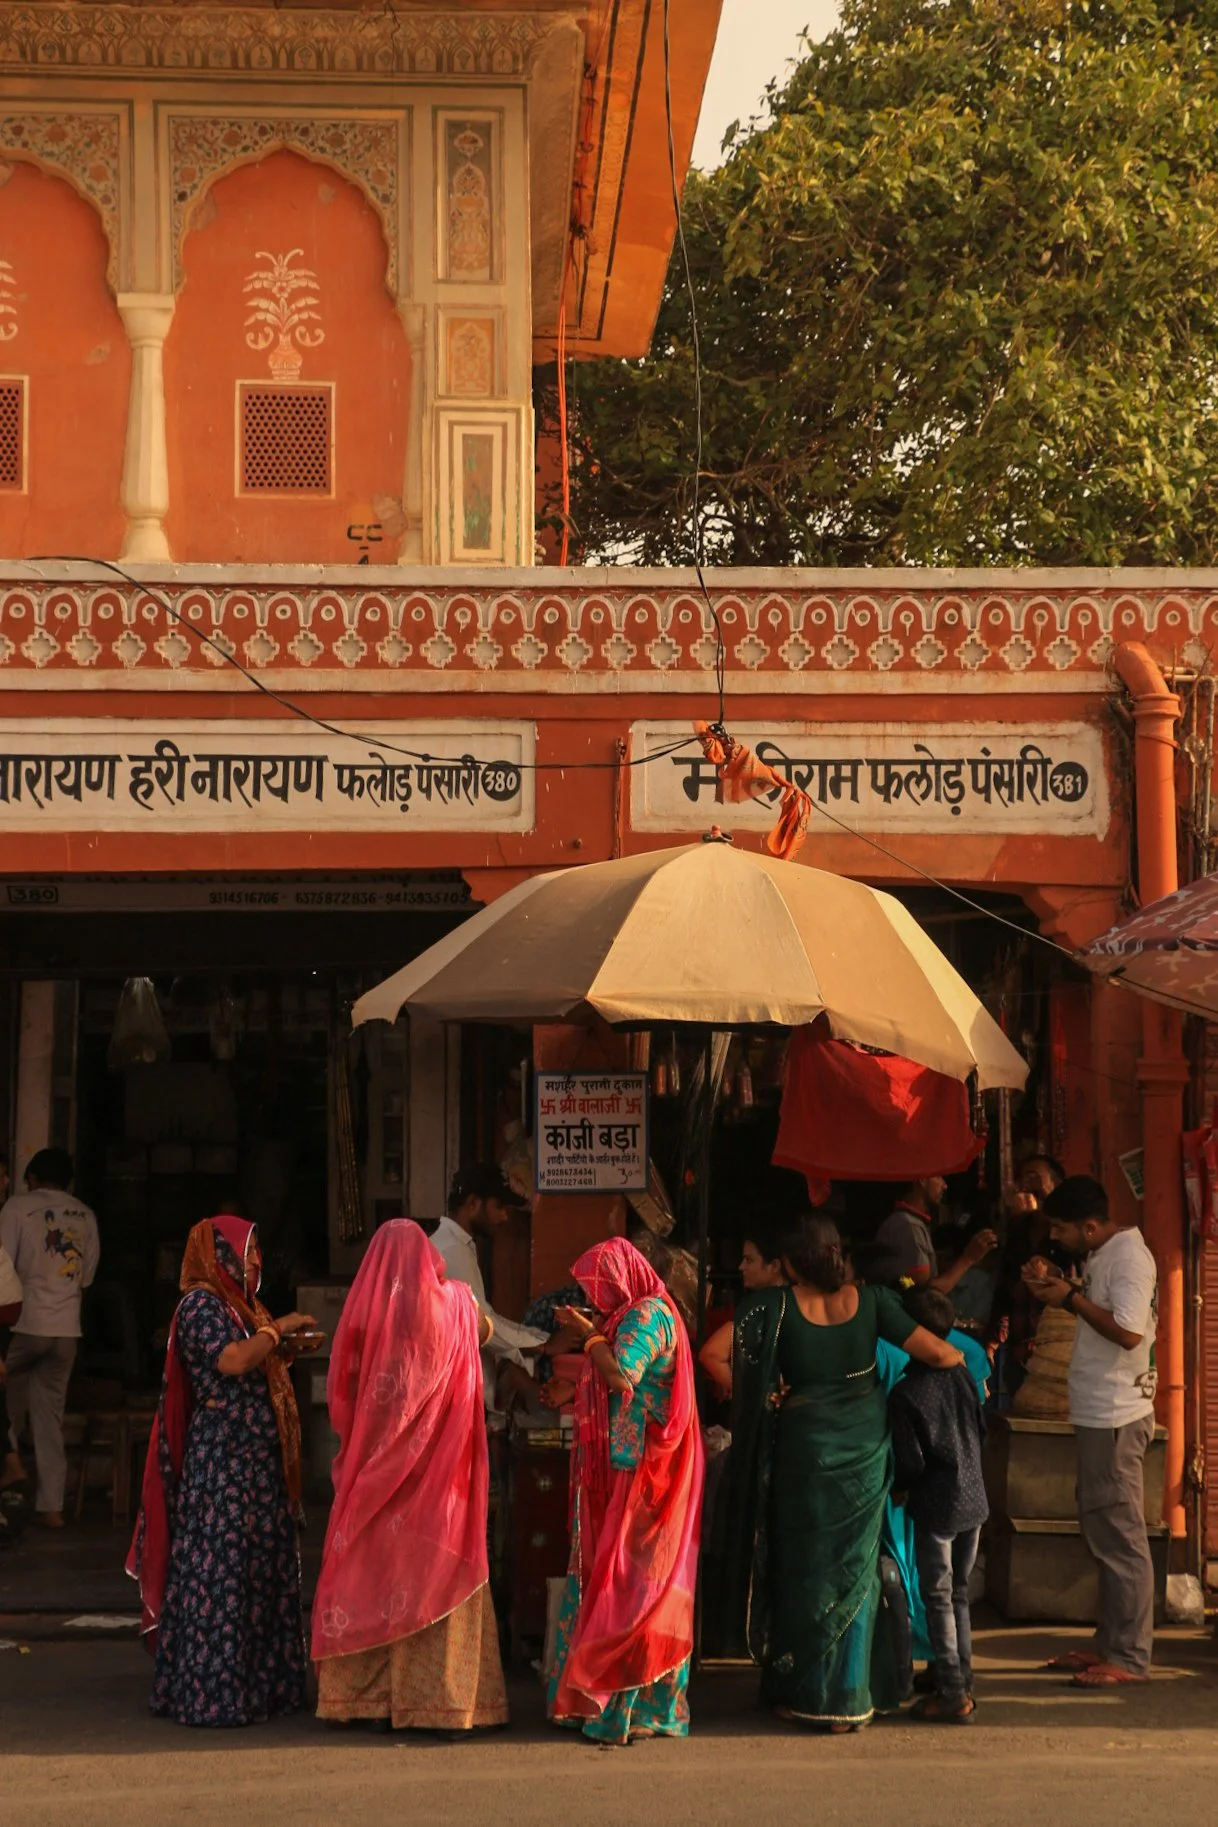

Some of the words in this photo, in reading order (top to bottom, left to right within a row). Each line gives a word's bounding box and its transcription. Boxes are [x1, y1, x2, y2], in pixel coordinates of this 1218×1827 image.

[127, 739, 191, 811] हरी
[191, 754, 329, 808] नारायण
[333, 752, 414, 812] फलोड़
[484, 769, 518, 792] 380
[865, 744, 965, 816] फलोड़
[966, 744, 1053, 808] पंसारी
[1051, 774, 1082, 791] 381
[14, 888, 55, 901] 380
[560, 1093, 577, 1114] श्री
[544, 1117, 595, 1151] कांजी
[597, 1124, 640, 1152] बड़ा
